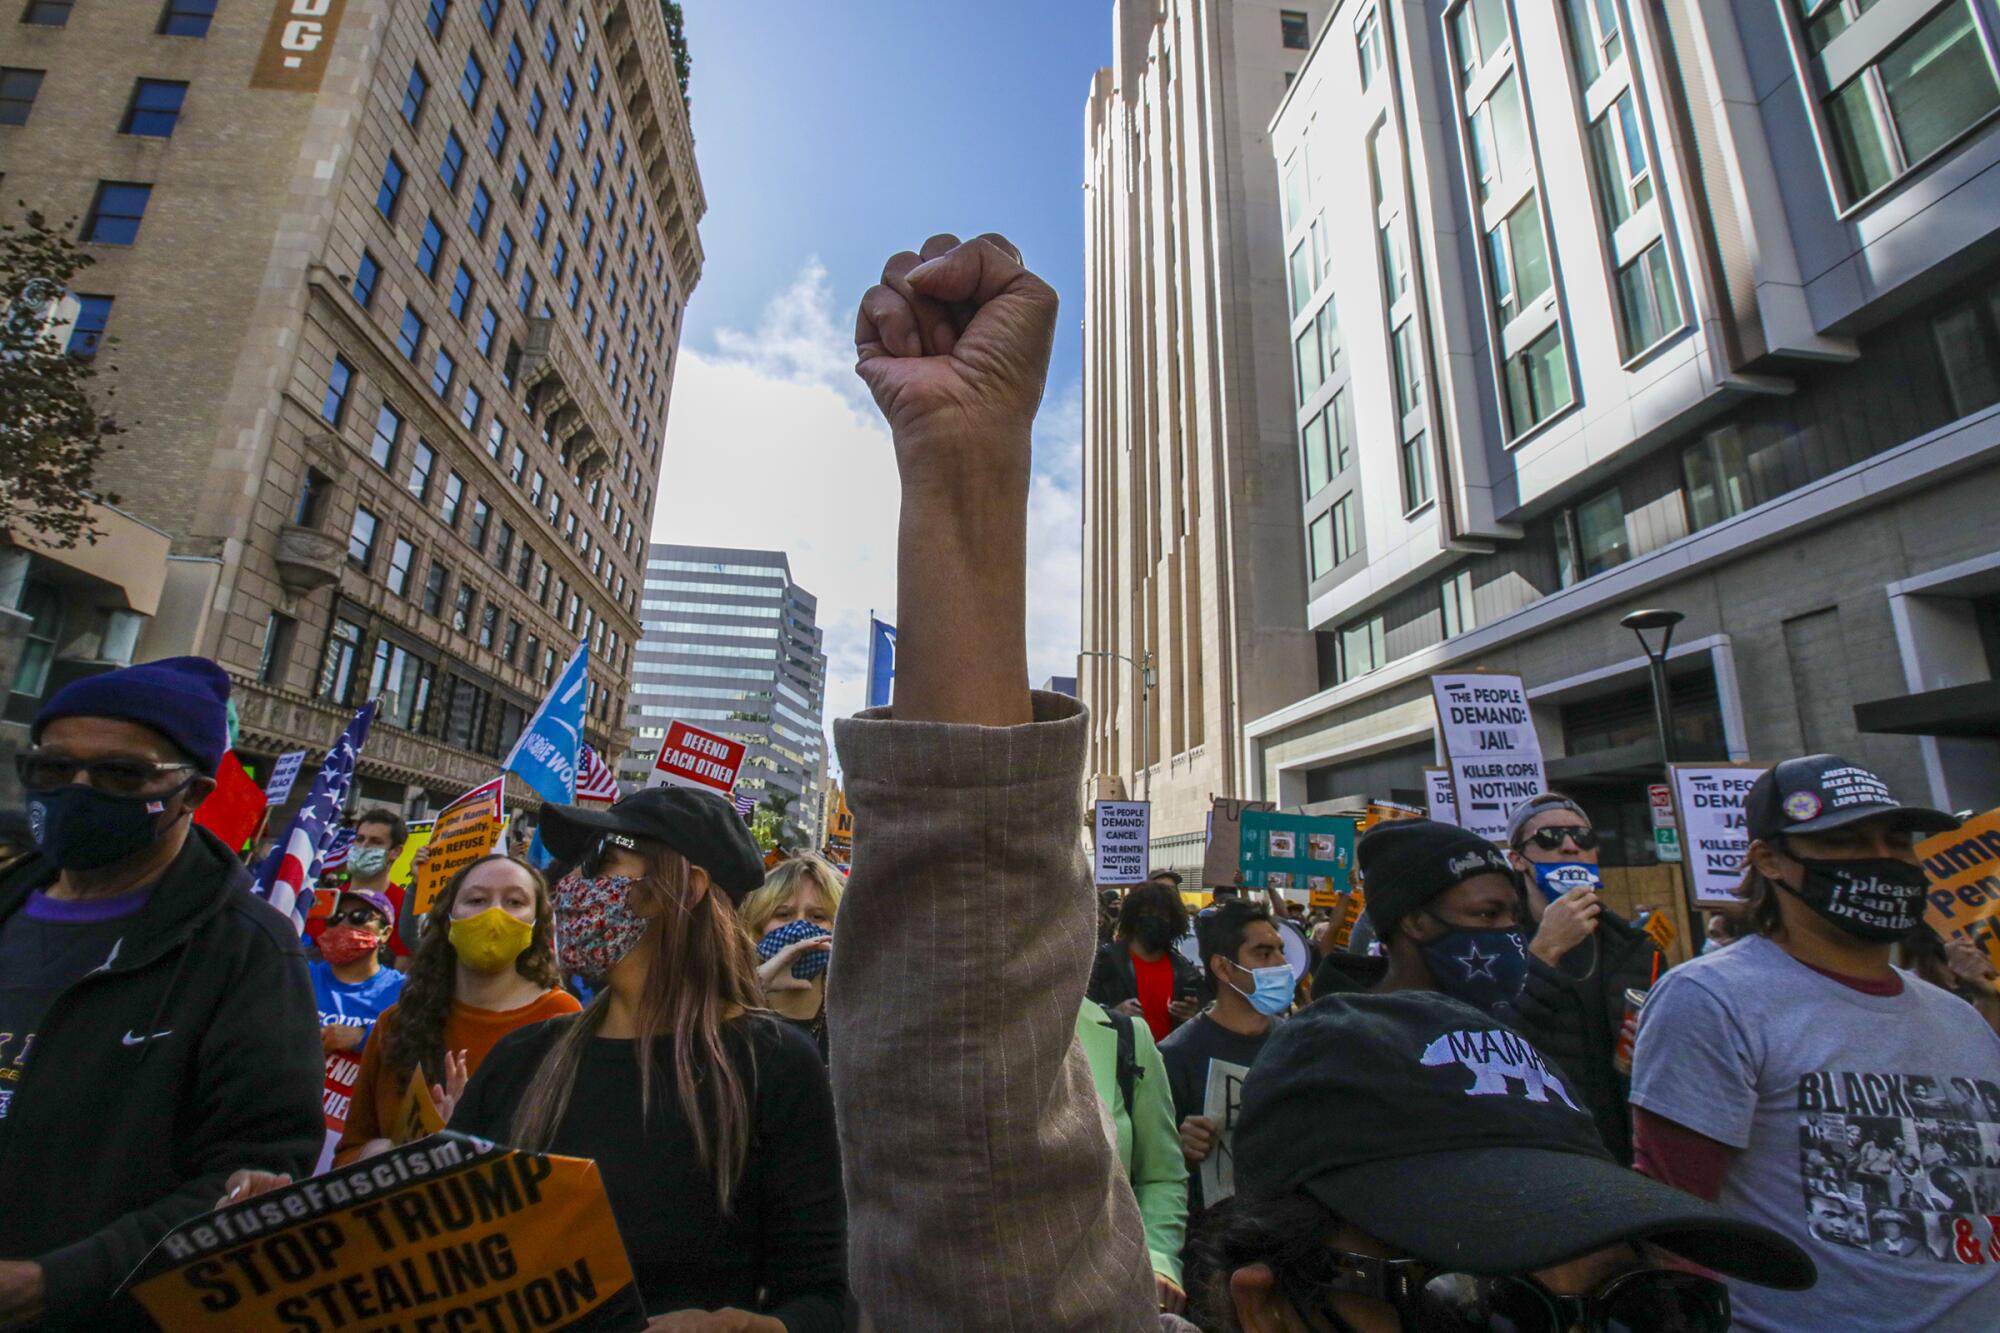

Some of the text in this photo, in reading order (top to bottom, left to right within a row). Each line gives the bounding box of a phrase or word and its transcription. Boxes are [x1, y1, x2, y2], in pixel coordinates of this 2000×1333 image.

[1450, 688, 1521, 703] THE PEOPLE
[1451, 707, 1527, 724] DEMAND:
[681, 731, 730, 760] DEFEND
[1479, 731, 1515, 750] JAIL
[662, 747, 734, 784] EACH OTHER
[1462, 763, 1539, 779] KILLER COPS!
[1470, 780, 1538, 800] NOTHING
[1694, 782, 1719, 791] THE
[1116, 808, 1144, 817] PEOPLE
[1102, 818, 1144, 828] DEMAND:
[1105, 831, 1138, 840] CANCEL
[446, 836, 485, 854] REFUSE
[1102, 845, 1117, 854] THE
[431, 862, 442, 873] to
[1103, 855, 1141, 864] NOTHING
[1119, 865, 1141, 875] LESS!
[1447, 1030, 1549, 1077] MAMA
[1800, 1071, 1914, 1118] BLACK
[185, 1152, 554, 1314] STOP TRUMP
[275, 1232, 519, 1333] STEALING
